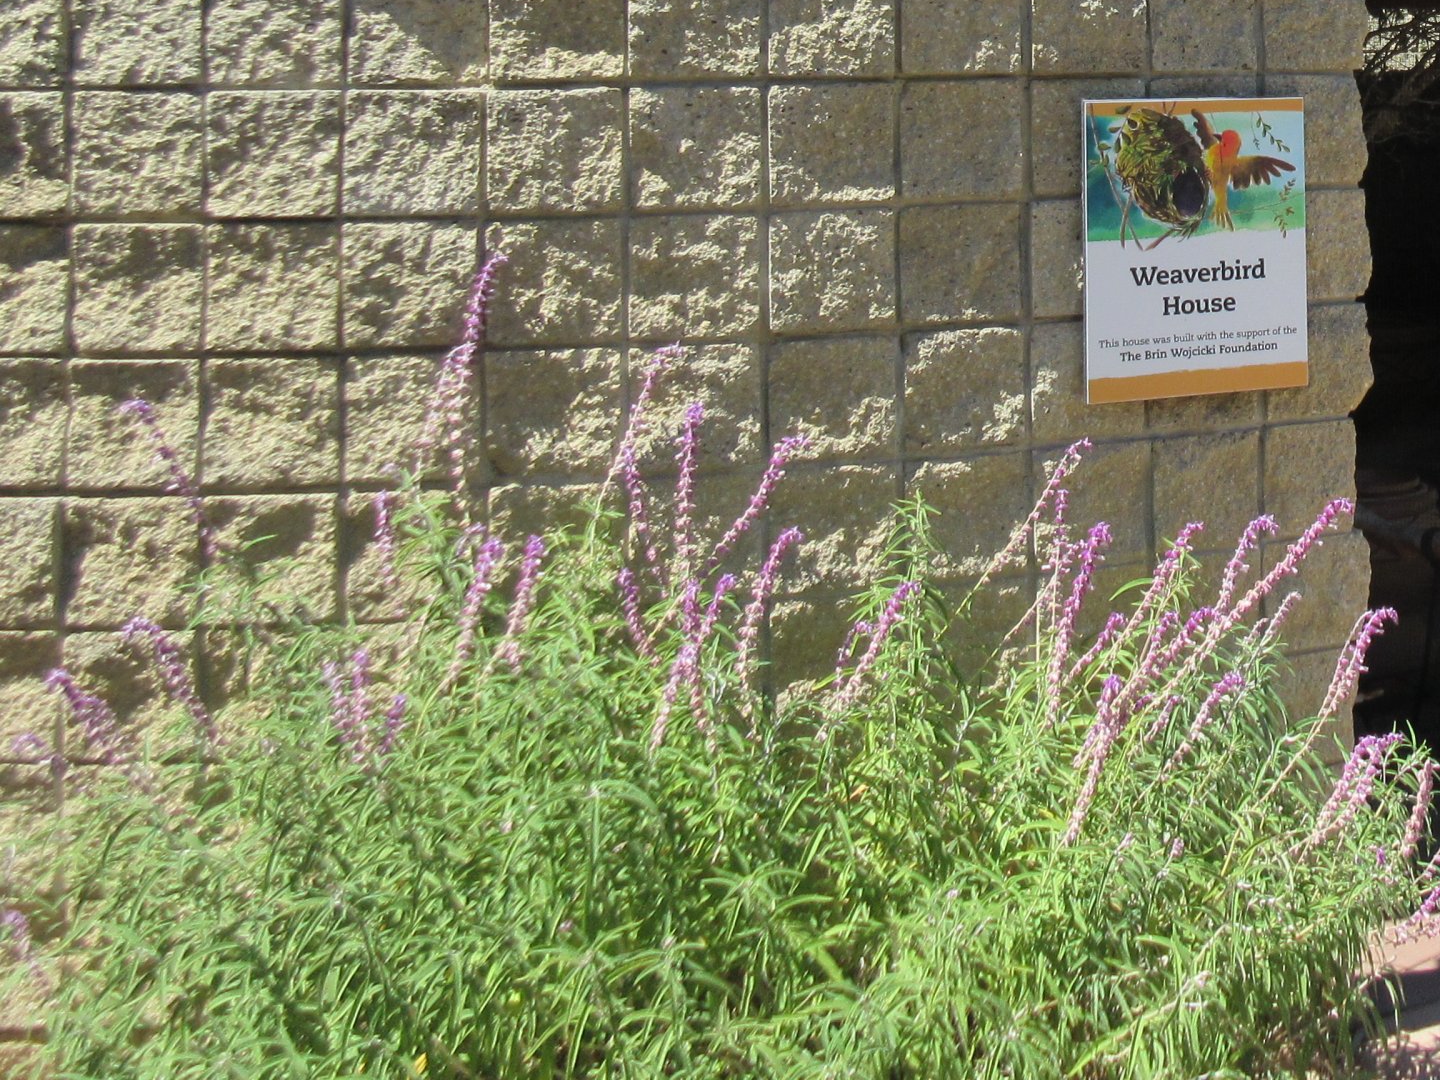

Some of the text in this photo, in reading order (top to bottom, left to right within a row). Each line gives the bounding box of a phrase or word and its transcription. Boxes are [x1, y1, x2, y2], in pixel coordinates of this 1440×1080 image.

[1130, 258, 1266, 286] Weaverbird
[1163, 296, 1236, 316] House
[1099, 326, 1297, 349] This house was built with the support of the
[1120, 341, 1278, 362] The Brin Wojcicki Foundation
